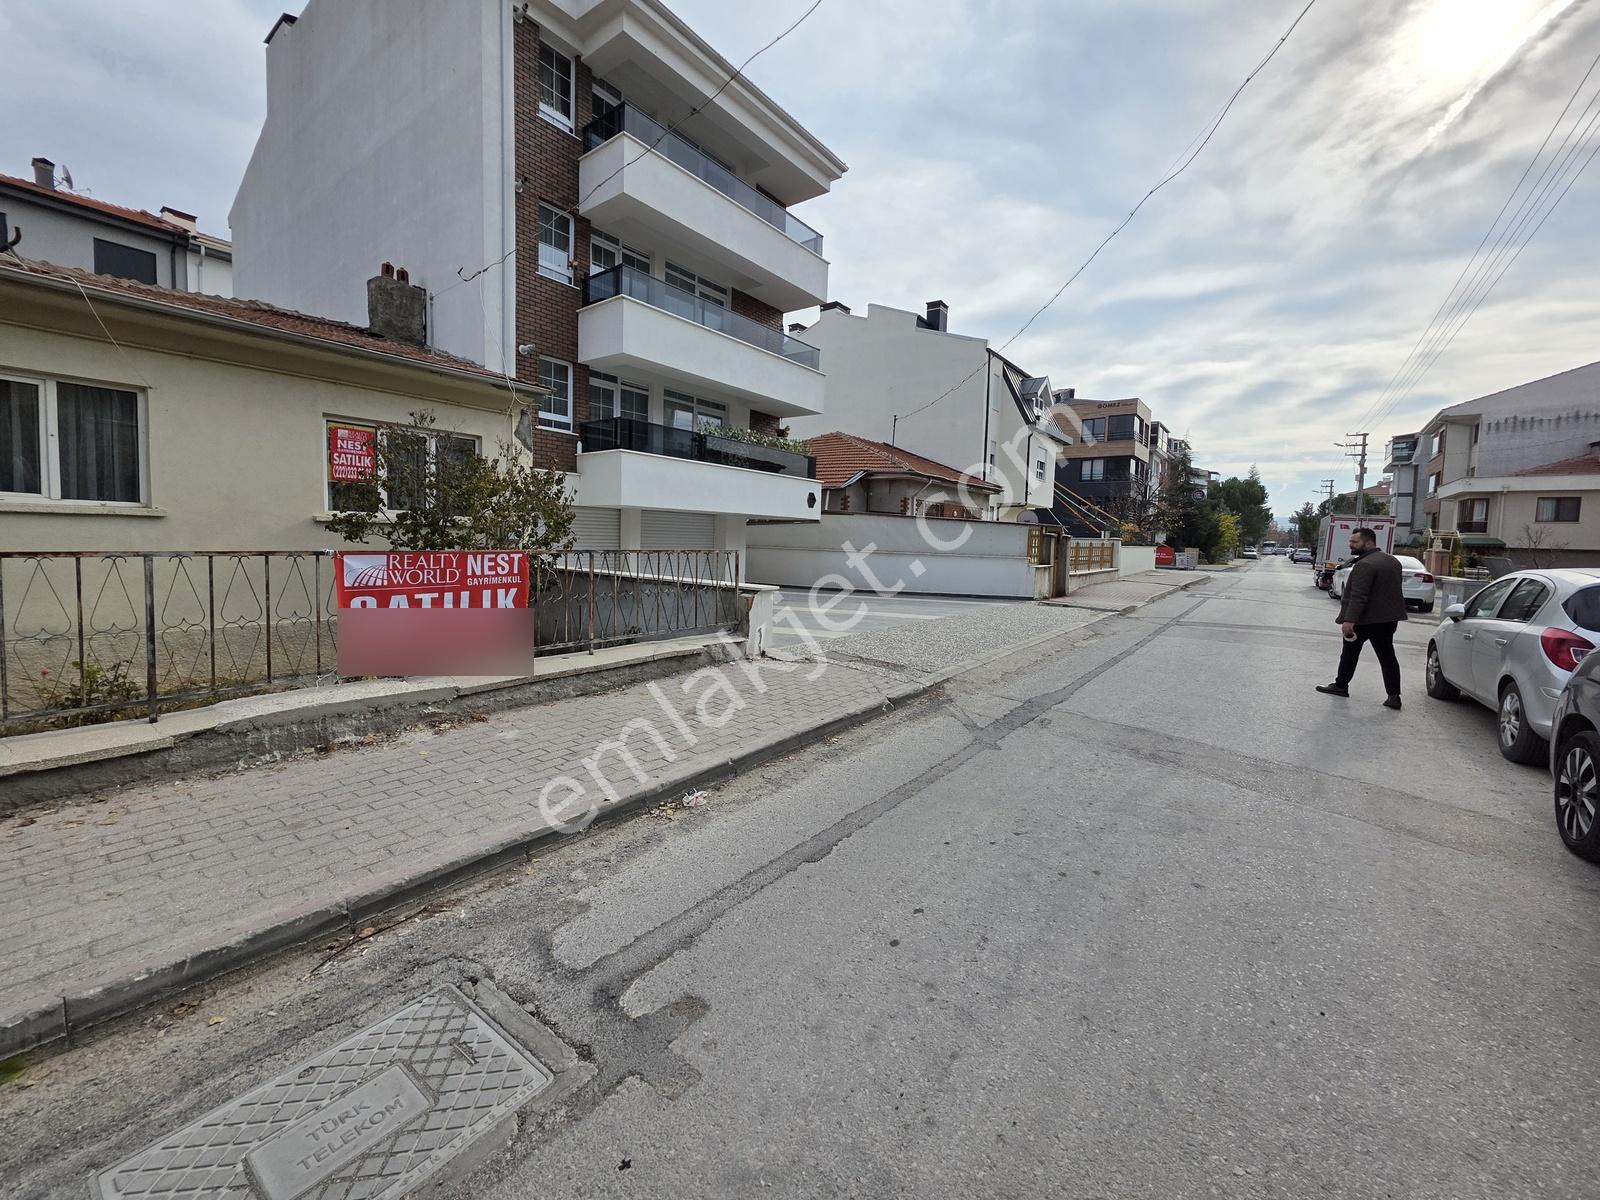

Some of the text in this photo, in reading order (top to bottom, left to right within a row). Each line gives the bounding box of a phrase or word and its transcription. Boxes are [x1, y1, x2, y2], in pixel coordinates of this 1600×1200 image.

[333, 453, 371, 467] SATILIK
[390, 554, 460, 569] REALTY
[467, 554, 522, 575] NEST
[389, 569, 460, 585] WORLD
[466, 575, 523, 586] GAYRİMENKUL
[305, 1101, 371, 1141] TÜRK
[296, 1098, 404, 1170] TELEKOM
